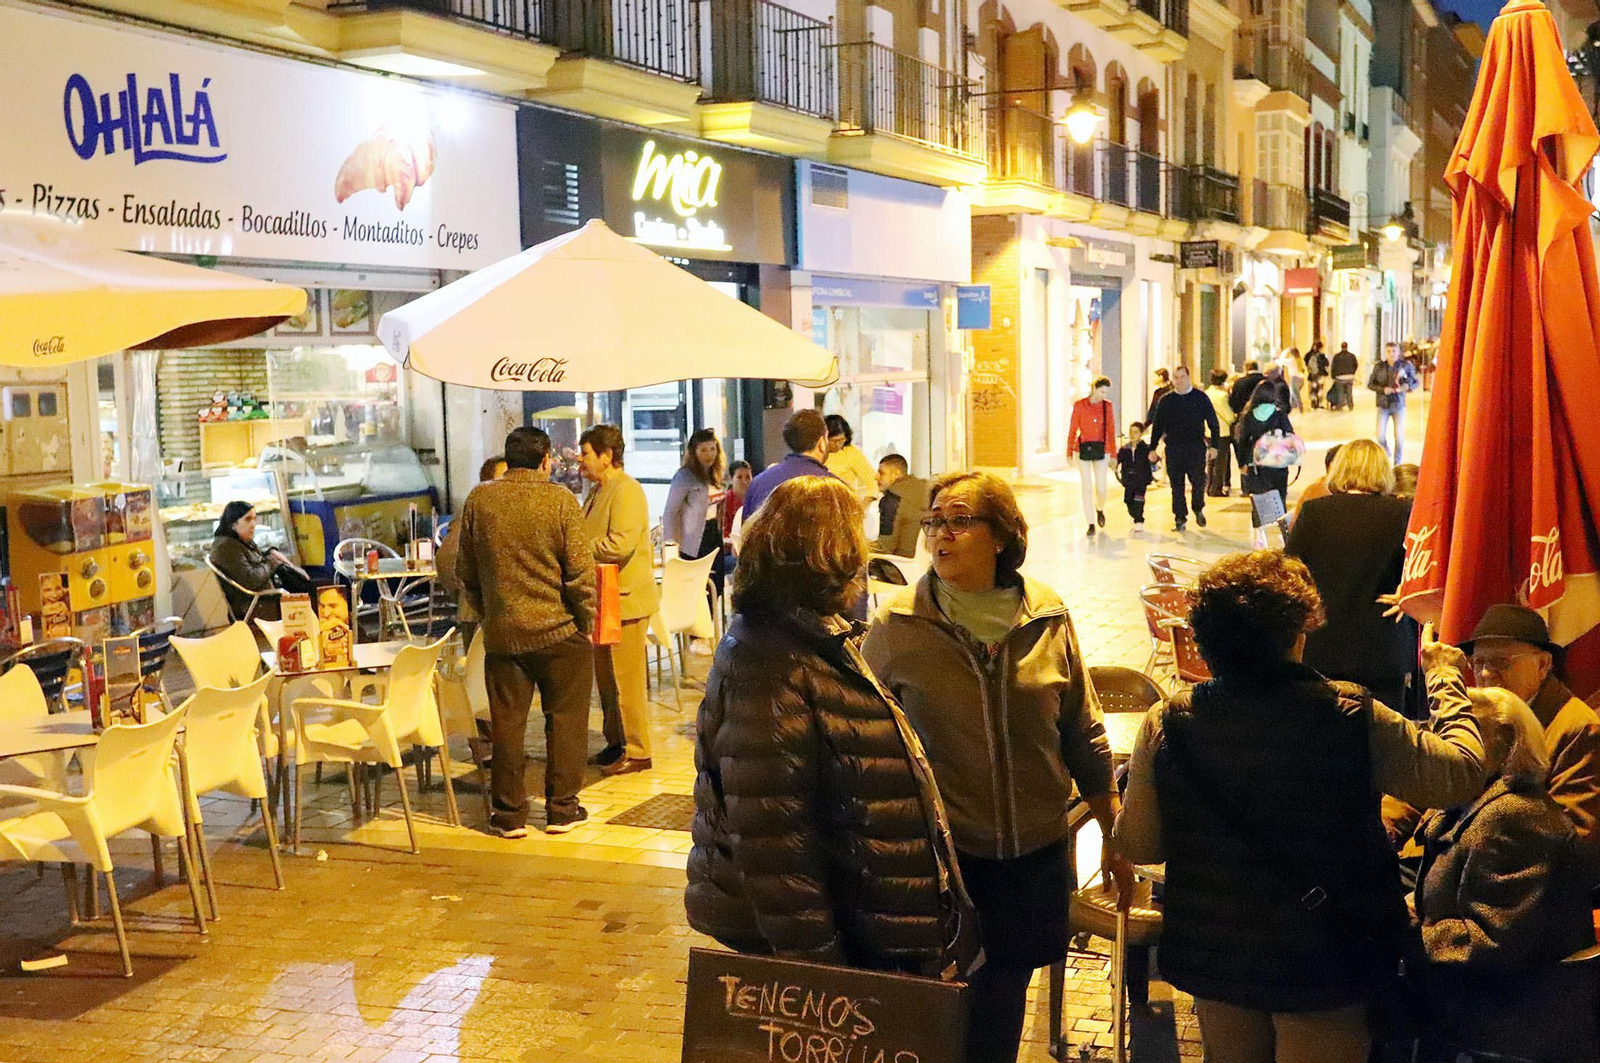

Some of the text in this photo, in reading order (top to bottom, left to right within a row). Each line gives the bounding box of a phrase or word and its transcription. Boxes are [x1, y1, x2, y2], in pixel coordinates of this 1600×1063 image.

[32, 184, 100, 222] Pizzas
[123, 194, 221, 230] Ensaladas
[242, 205, 327, 238] Bocadillos
[343, 216, 423, 246] Montaditos
[437, 224, 479, 254] Crepes
[490, 356, 569, 383] Coca-Cola
[1529, 526, 1563, 593] ola
[718, 973, 878, 1038] TENEMOS
